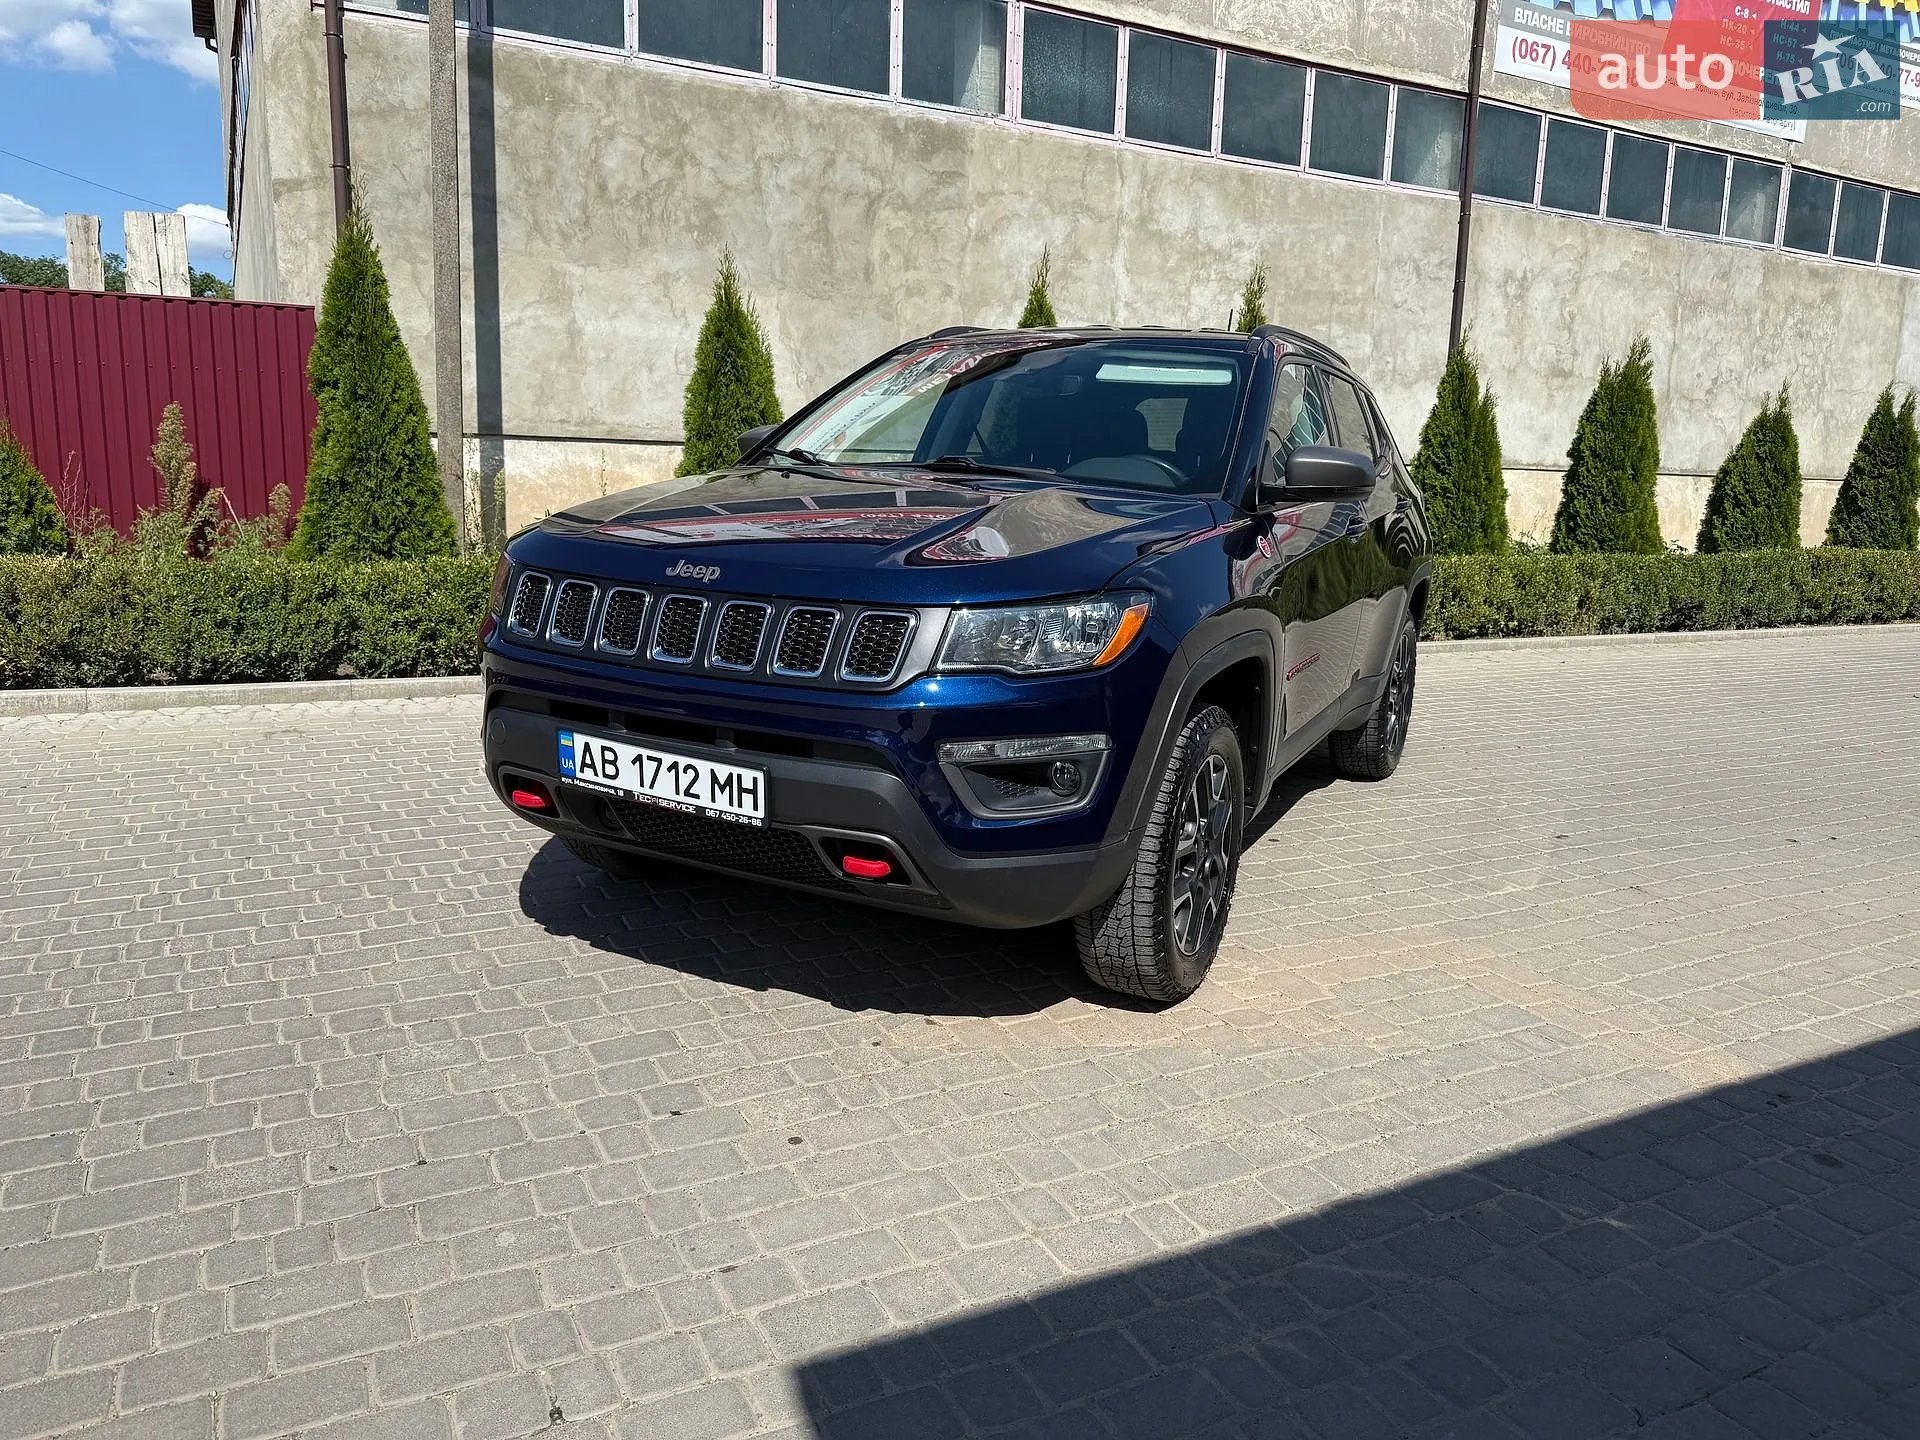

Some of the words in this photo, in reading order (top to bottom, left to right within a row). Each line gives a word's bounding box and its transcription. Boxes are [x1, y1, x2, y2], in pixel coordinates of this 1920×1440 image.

[1734, 5, 1750, 19] С-8
[1514, 7, 1565, 35] ВЛАСНЕ
[1566, 21, 1651, 56] ВИРОБНИЦТВО
[1511, 36, 1557, 71] (067)
[666, 559, 721, 584] Jeep
[561, 759, 575, 770] UA
[579, 741, 620, 780] AB
[631, 754, 701, 800] 1712
[710, 768, 759, 812] MH
[705, 808, 720, 818] 067
